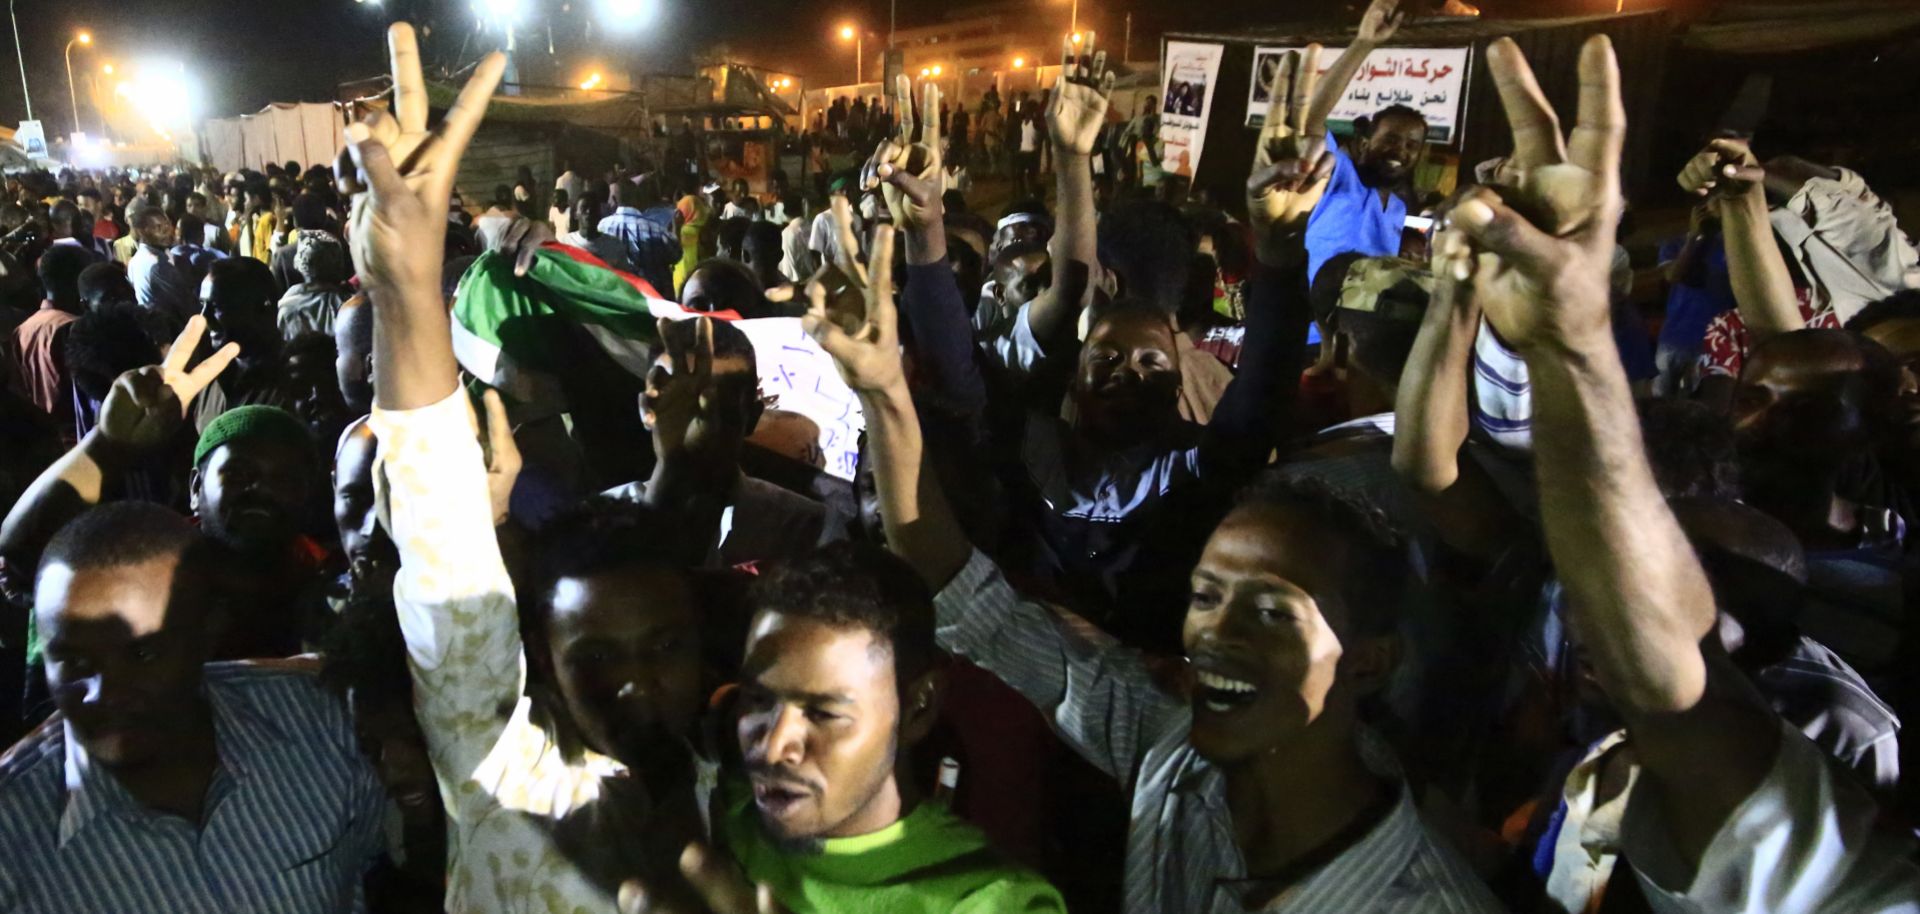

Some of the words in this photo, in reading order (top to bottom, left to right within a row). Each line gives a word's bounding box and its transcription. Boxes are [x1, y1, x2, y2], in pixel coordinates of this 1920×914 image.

[1404, 57, 1453, 83] حركة
[1348, 87, 1371, 105] بناء
[1420, 90, 1447, 107] نحن
